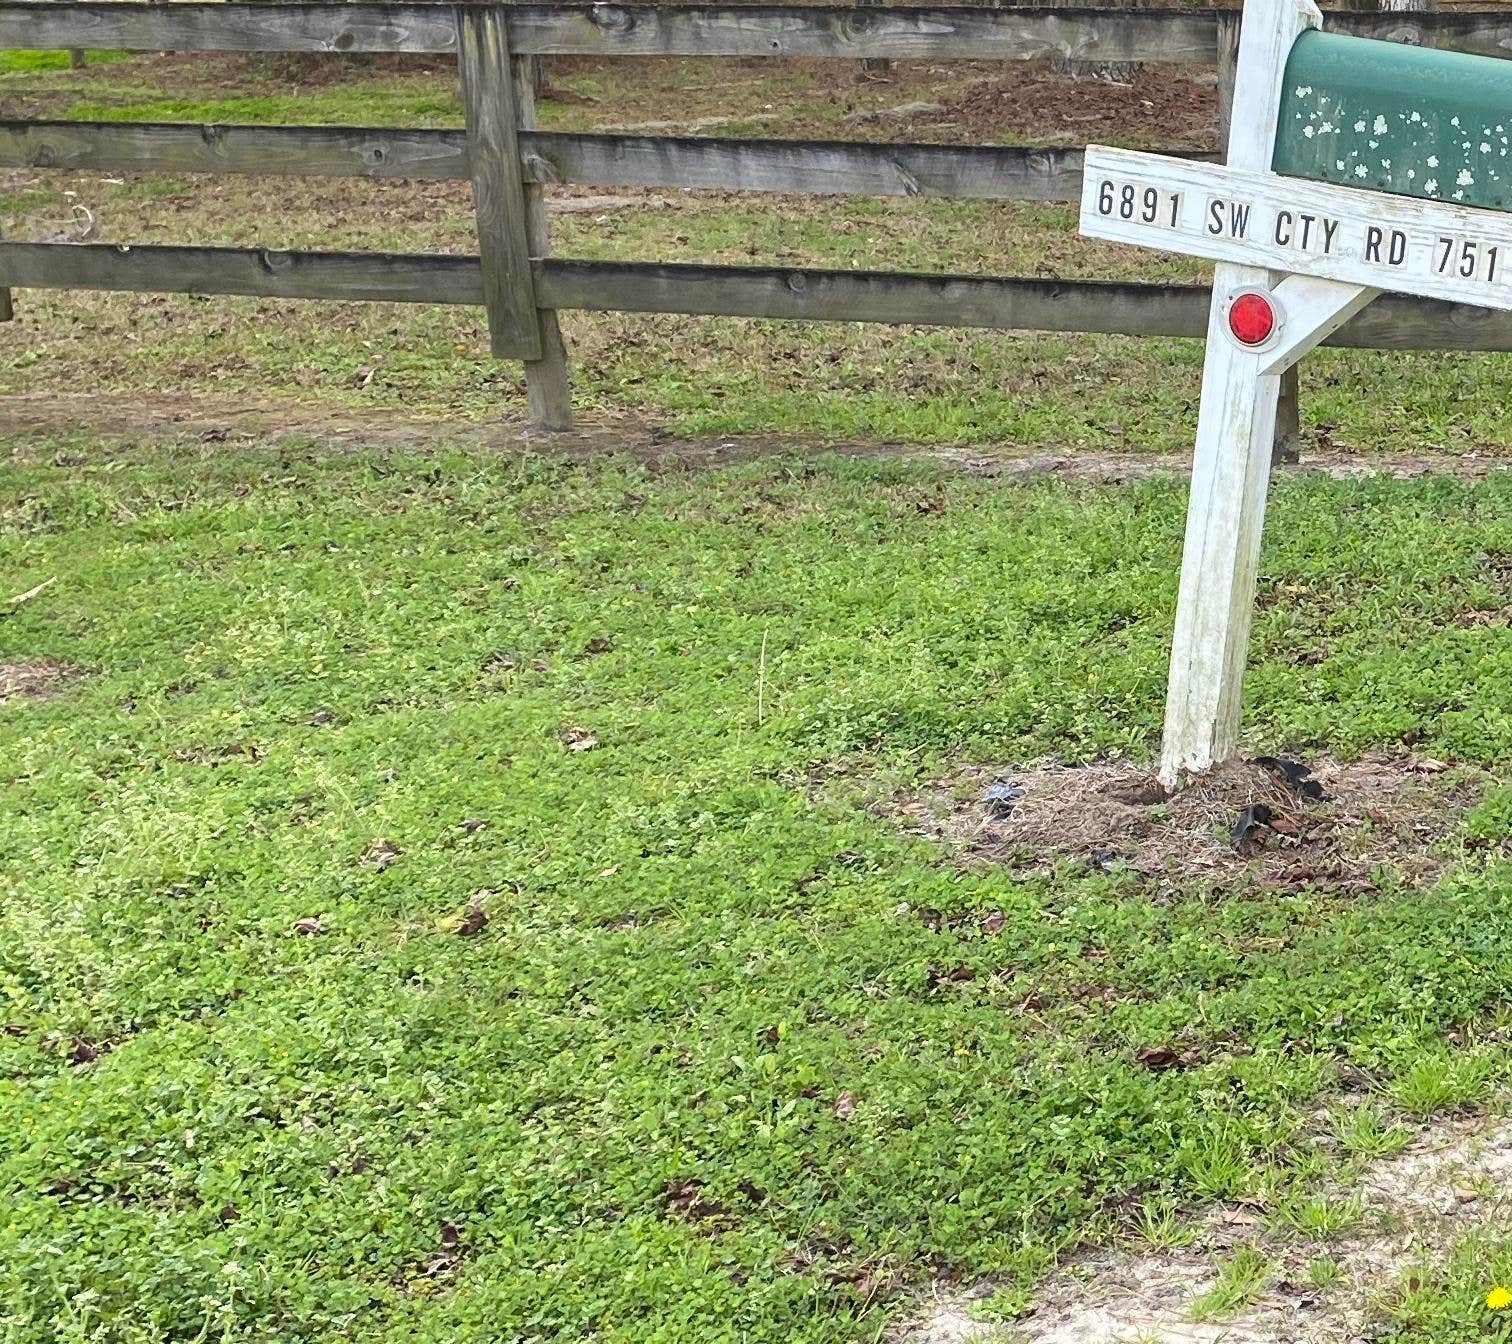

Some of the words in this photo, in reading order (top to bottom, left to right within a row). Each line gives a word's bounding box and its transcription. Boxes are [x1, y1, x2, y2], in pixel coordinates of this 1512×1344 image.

[1098, 180, 1181, 228] 6891
[1207, 199, 1251, 239] SW
[1275, 211, 1340, 254] CTY
[1365, 226, 1407, 266] RD
[1438, 238, 1499, 282] 751
